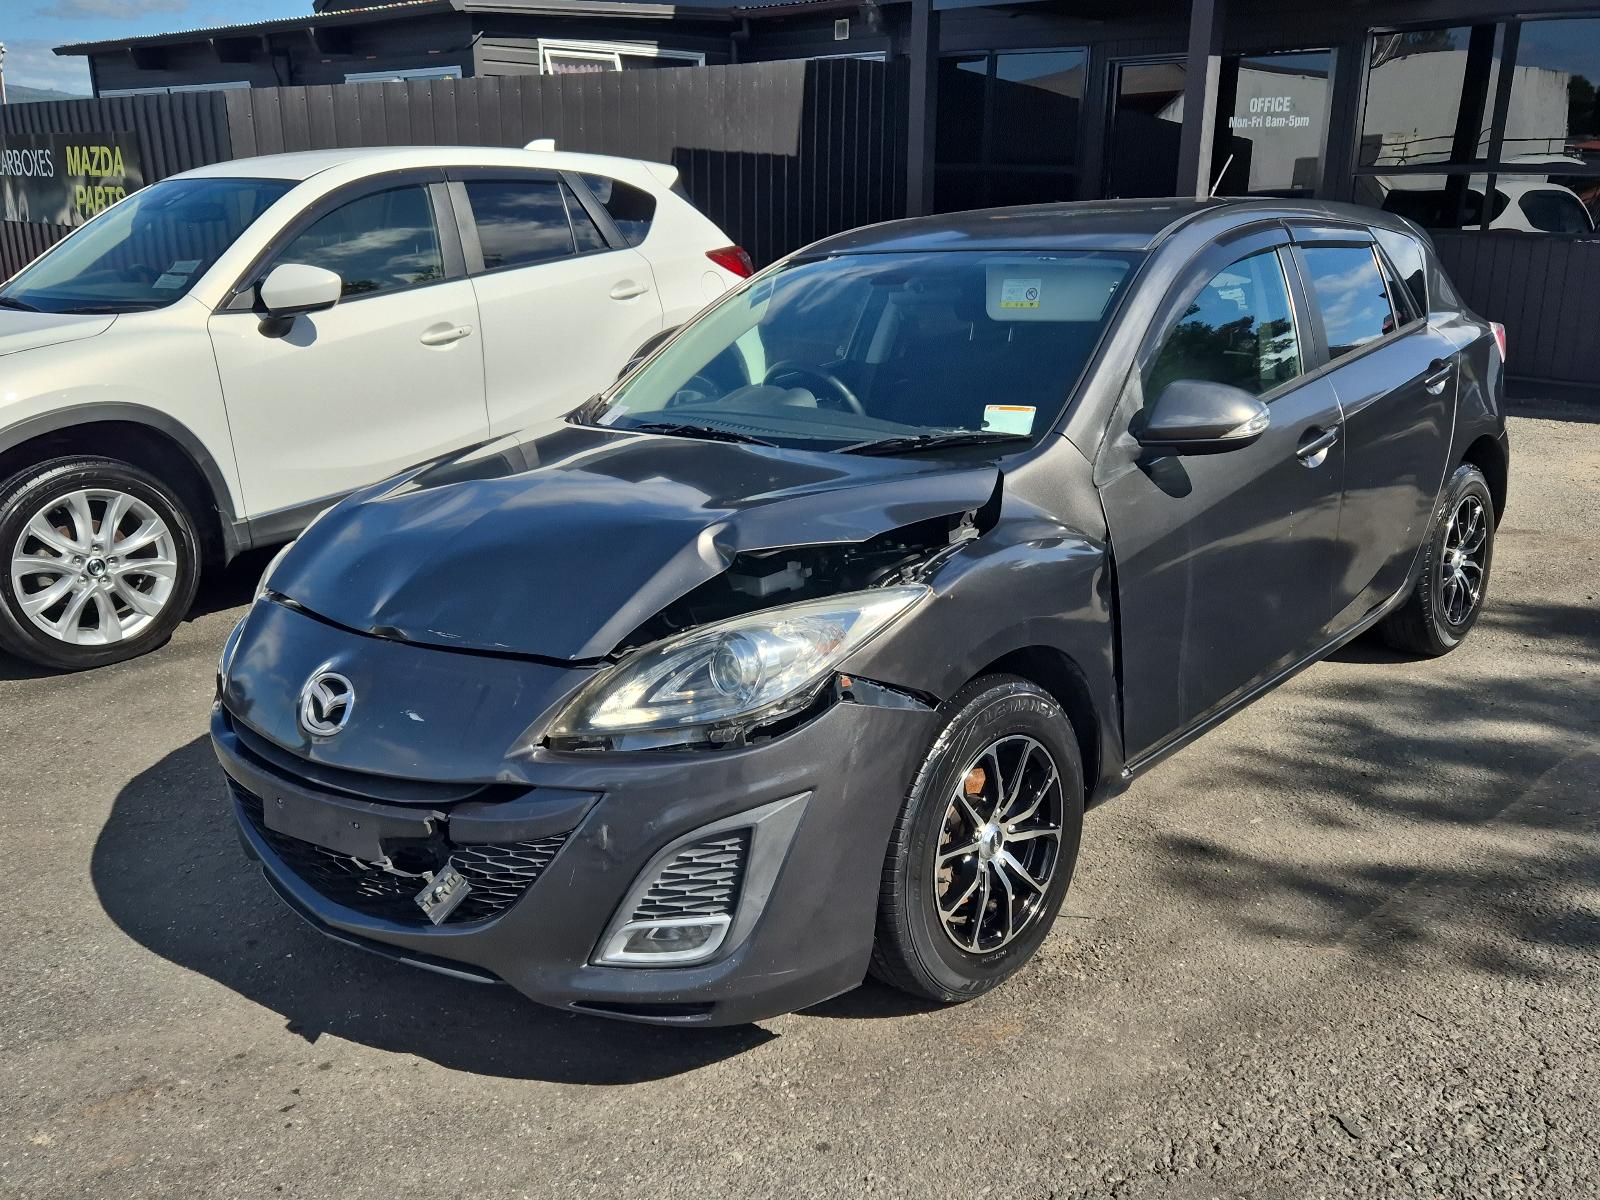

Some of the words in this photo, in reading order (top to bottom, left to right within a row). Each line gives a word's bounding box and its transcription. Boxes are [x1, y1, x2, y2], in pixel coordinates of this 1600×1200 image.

[1249, 96, 1291, 113] OFFICE
[1228, 116, 1263, 129] Mon-Fri
[1265, 115, 1310, 129] 8am-5pm
[0, 149, 54, 178] ARBOXES
[65, 145, 126, 177] MAZDA
